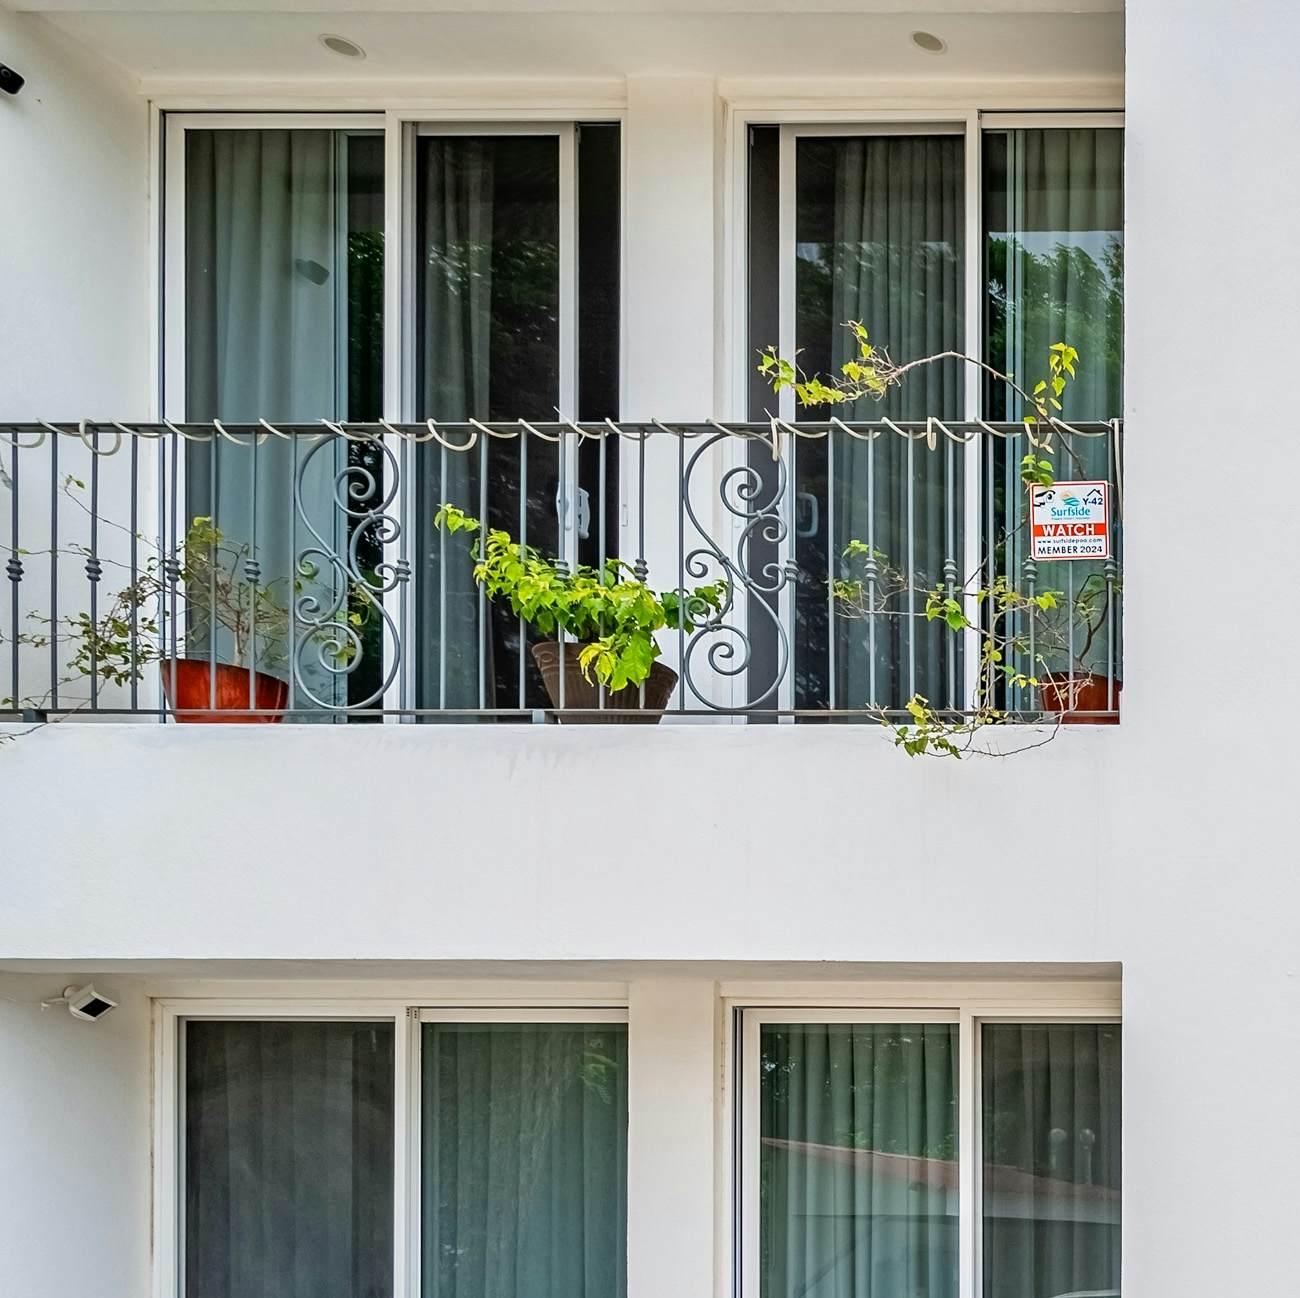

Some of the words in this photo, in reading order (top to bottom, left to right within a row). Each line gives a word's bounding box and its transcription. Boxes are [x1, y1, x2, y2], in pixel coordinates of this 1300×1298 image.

[1082, 498, 1104, 506] Y-42
[1050, 507, 1091, 517] Surfside
[1042, 524, 1095, 536] WATCH
[1037, 546, 1078, 555] MEMBER
